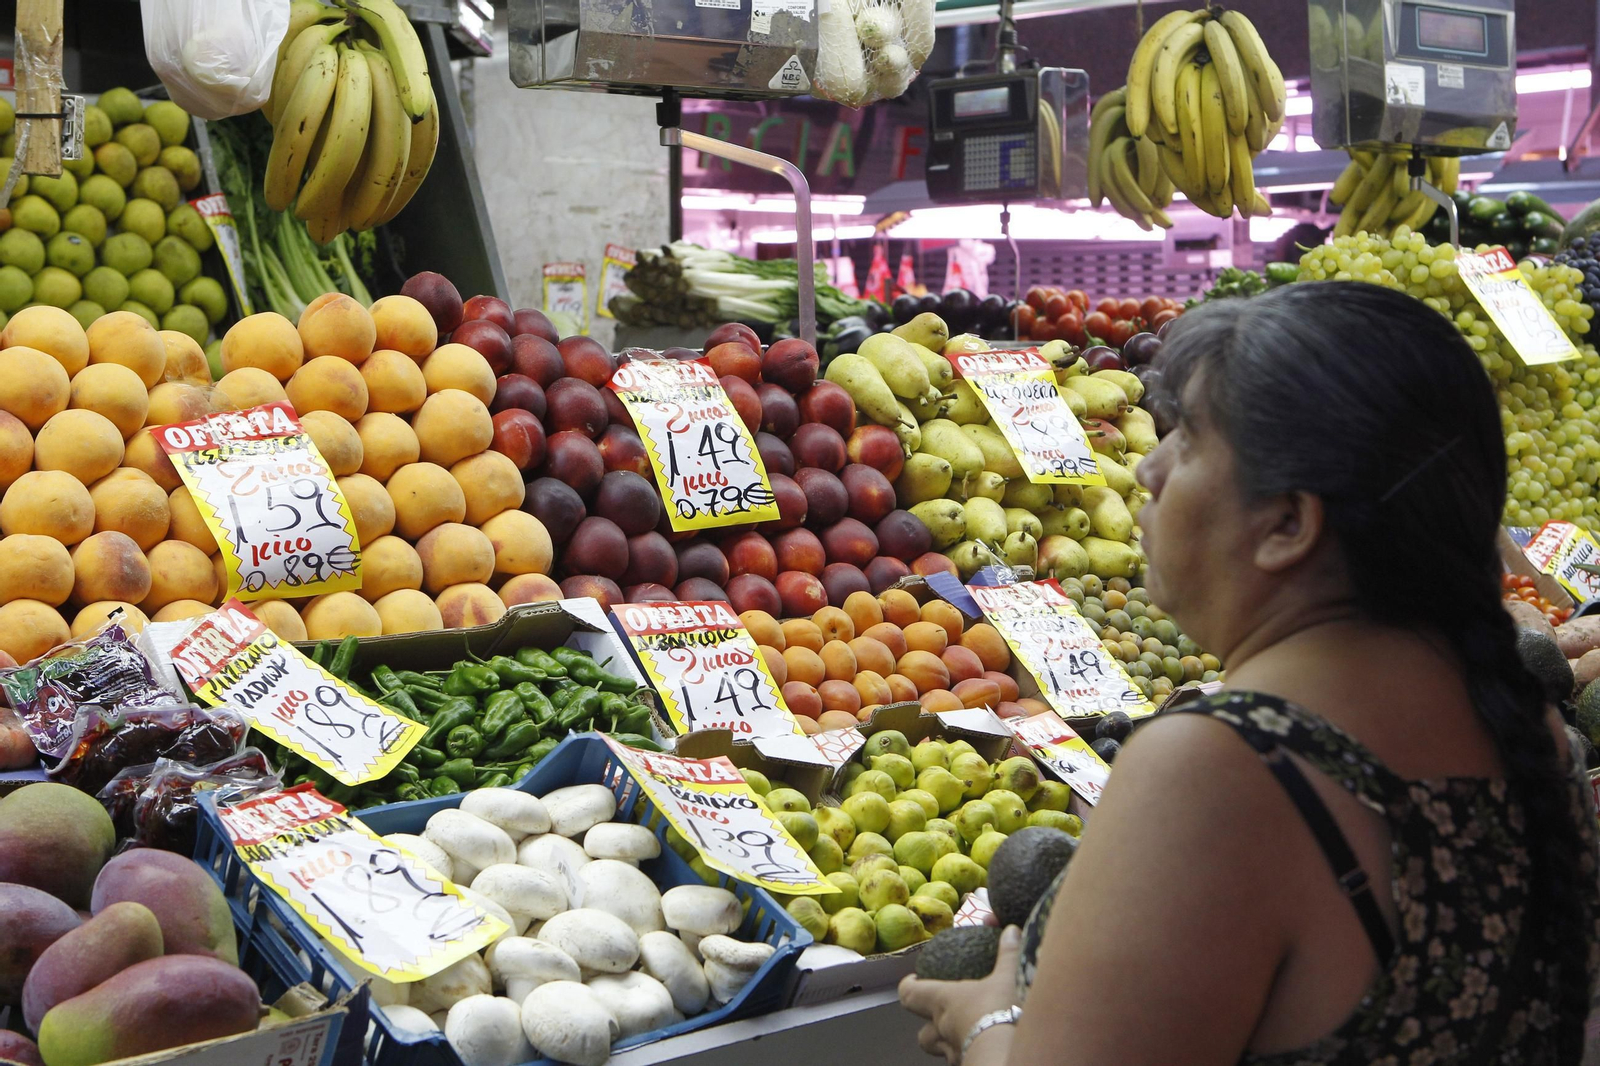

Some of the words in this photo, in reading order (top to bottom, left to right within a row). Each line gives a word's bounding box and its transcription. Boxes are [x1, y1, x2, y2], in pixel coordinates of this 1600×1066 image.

[612, 362, 714, 388] OTA
[164, 406, 298, 449] OFERTA
[654, 400, 690, 433] 2
[251, 534, 312, 567] KILO
[624, 604, 738, 632] OFERTA
[171, 606, 259, 684] OFERTA
[668, 646, 705, 685] 2
